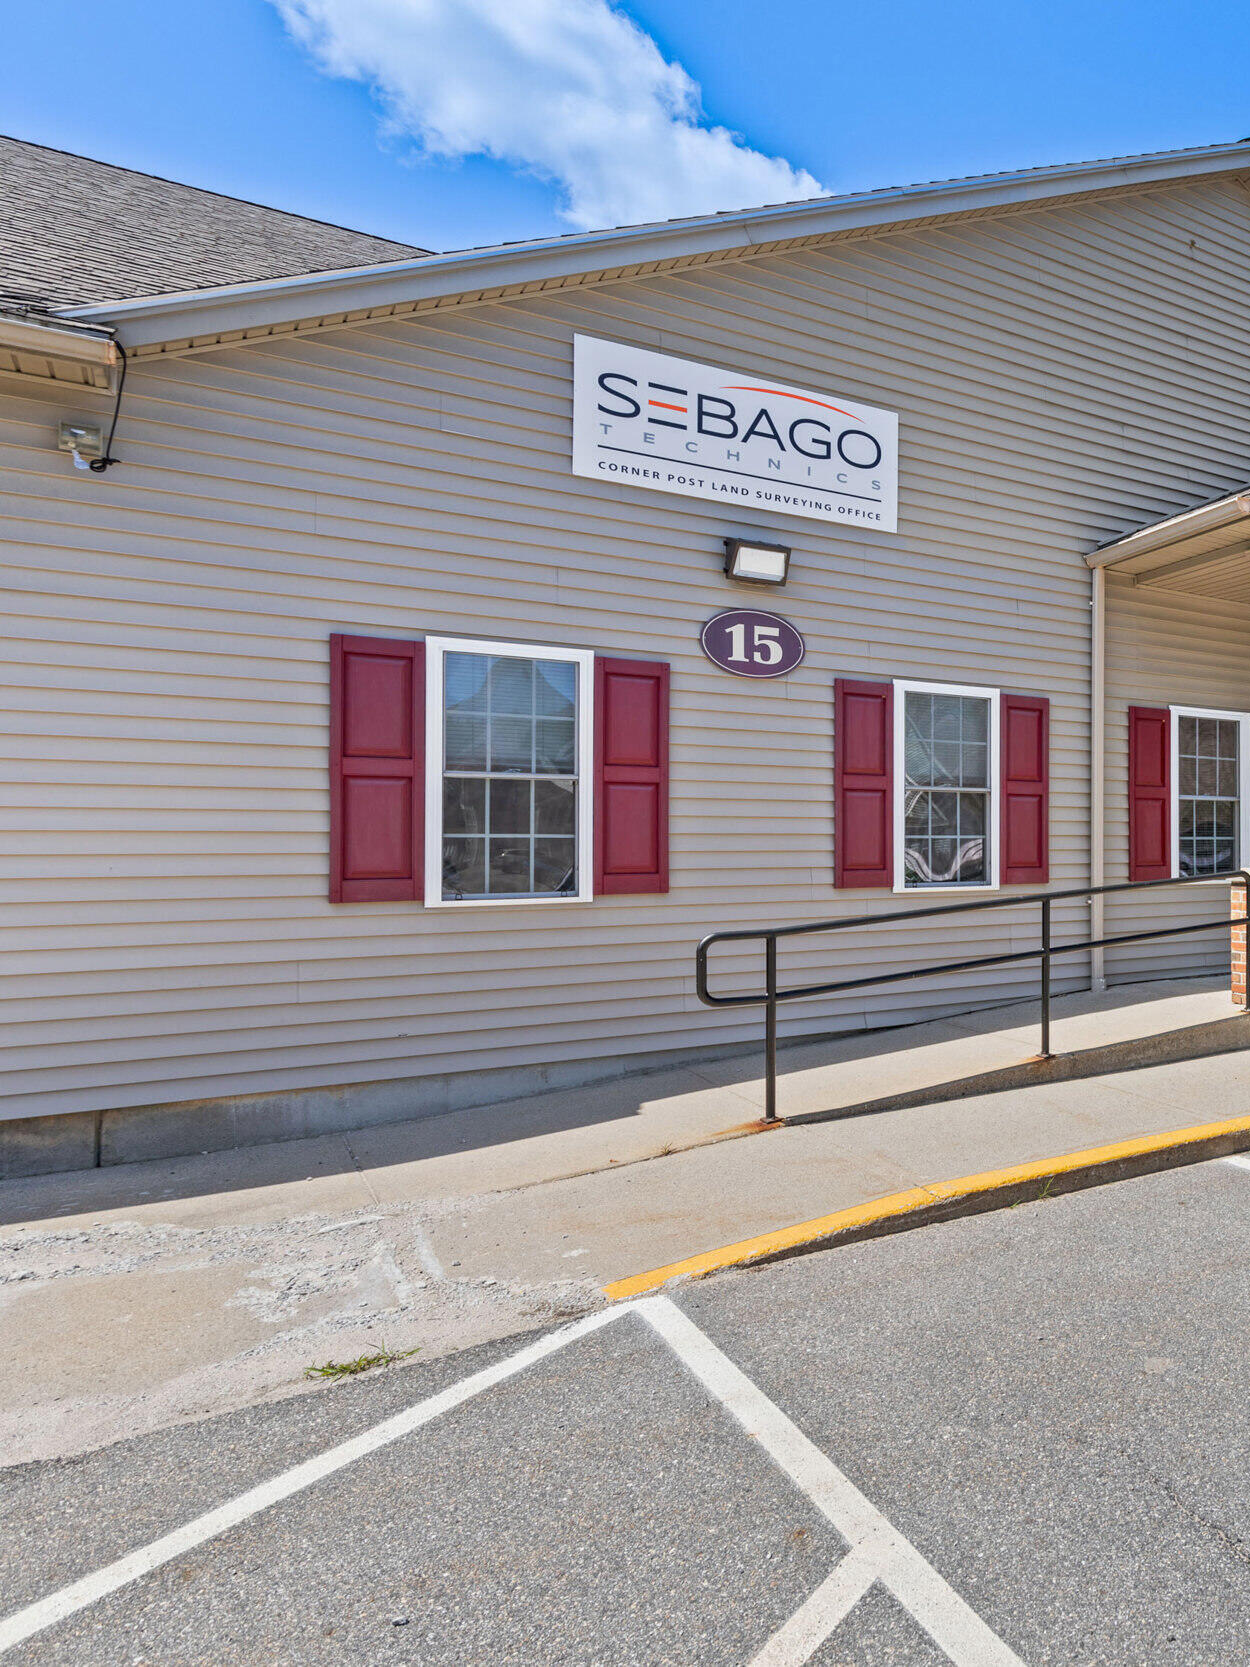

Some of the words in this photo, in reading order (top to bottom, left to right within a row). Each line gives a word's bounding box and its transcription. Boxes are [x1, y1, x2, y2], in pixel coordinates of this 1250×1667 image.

[597, 372, 882, 470] SEBAGO
[599, 423, 881, 491] TECHNICS
[598, 460, 661, 480] CORNER
[667, 474, 706, 489] POST
[712, 482, 750, 497] LAND
[756, 490, 833, 512] SURVEYING
[837, 506, 882, 522] OFFICE
[724, 623, 783, 665] 15
